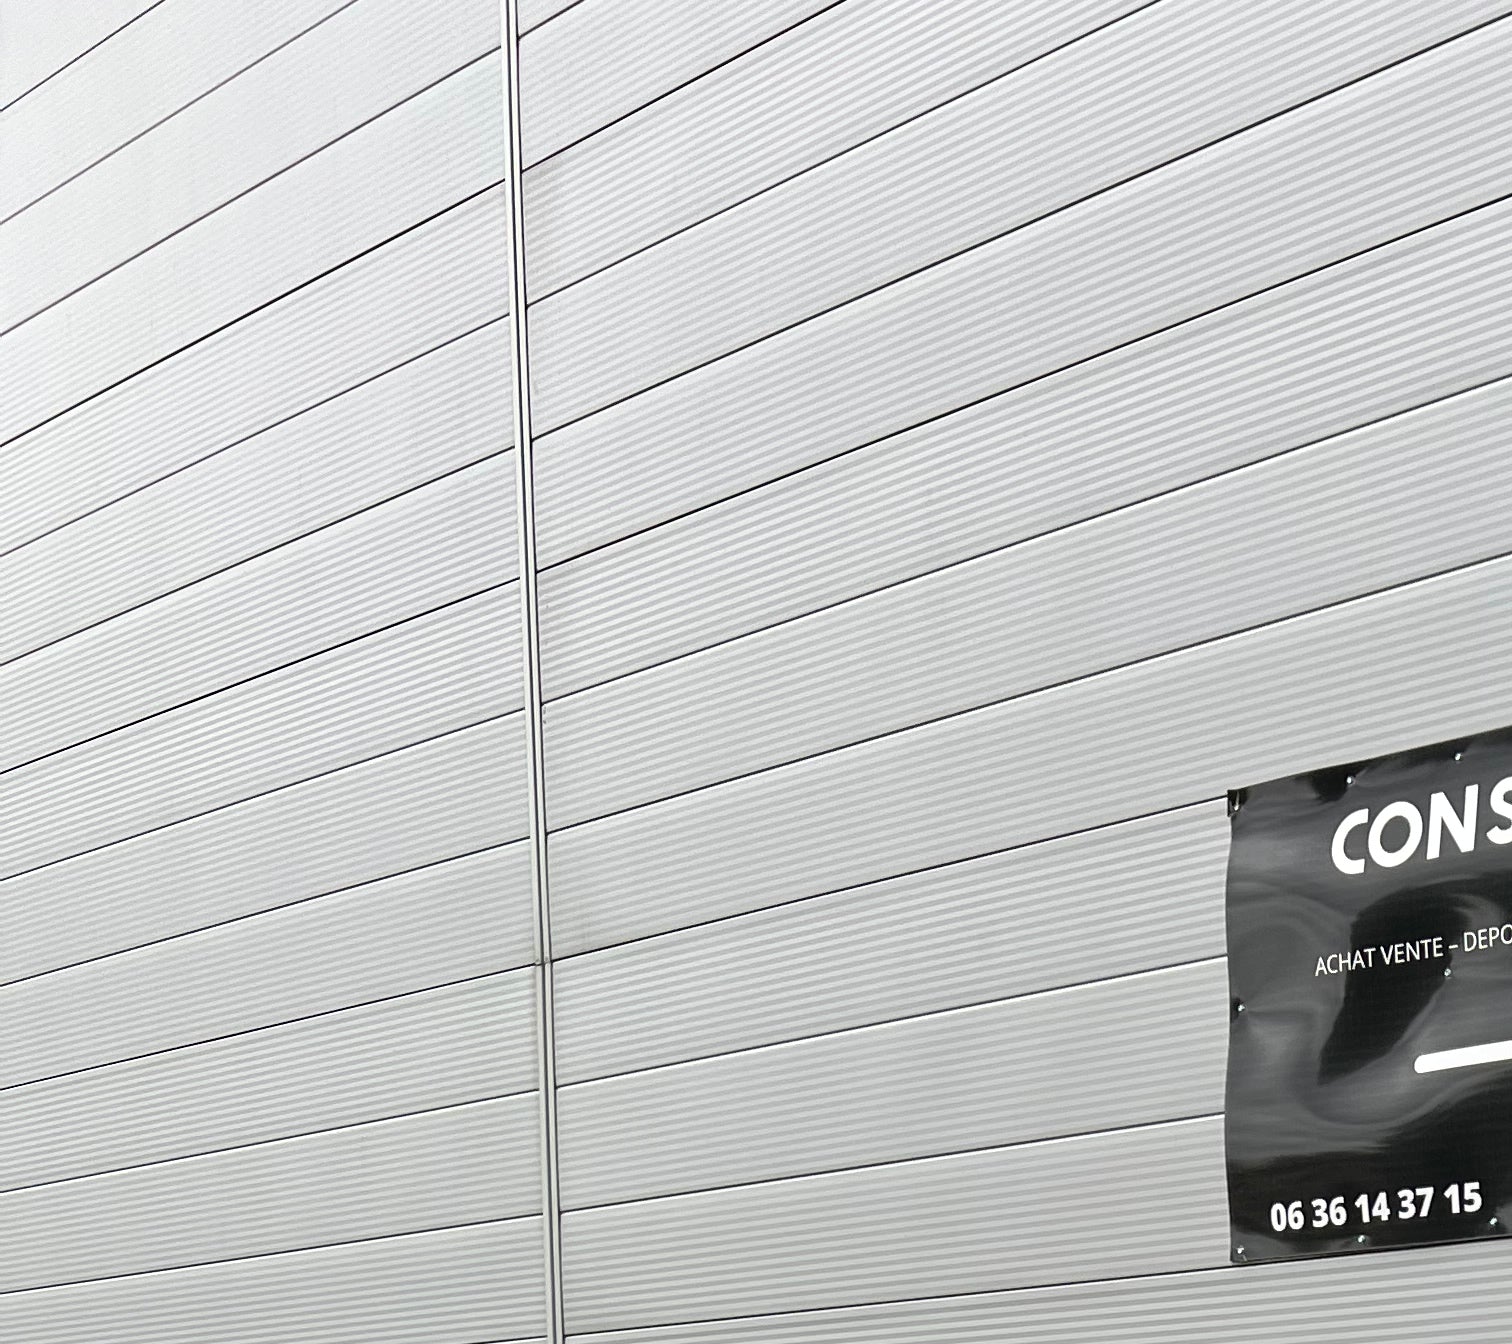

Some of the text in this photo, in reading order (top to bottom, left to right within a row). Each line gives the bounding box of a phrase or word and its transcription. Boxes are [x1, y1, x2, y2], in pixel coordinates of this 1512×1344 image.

[1315, 947, 1376, 976] ACHAT
[1380, 936, 1443, 964] VENTE
[1270, 1181, 1482, 1231] 06 36 14 37 15
